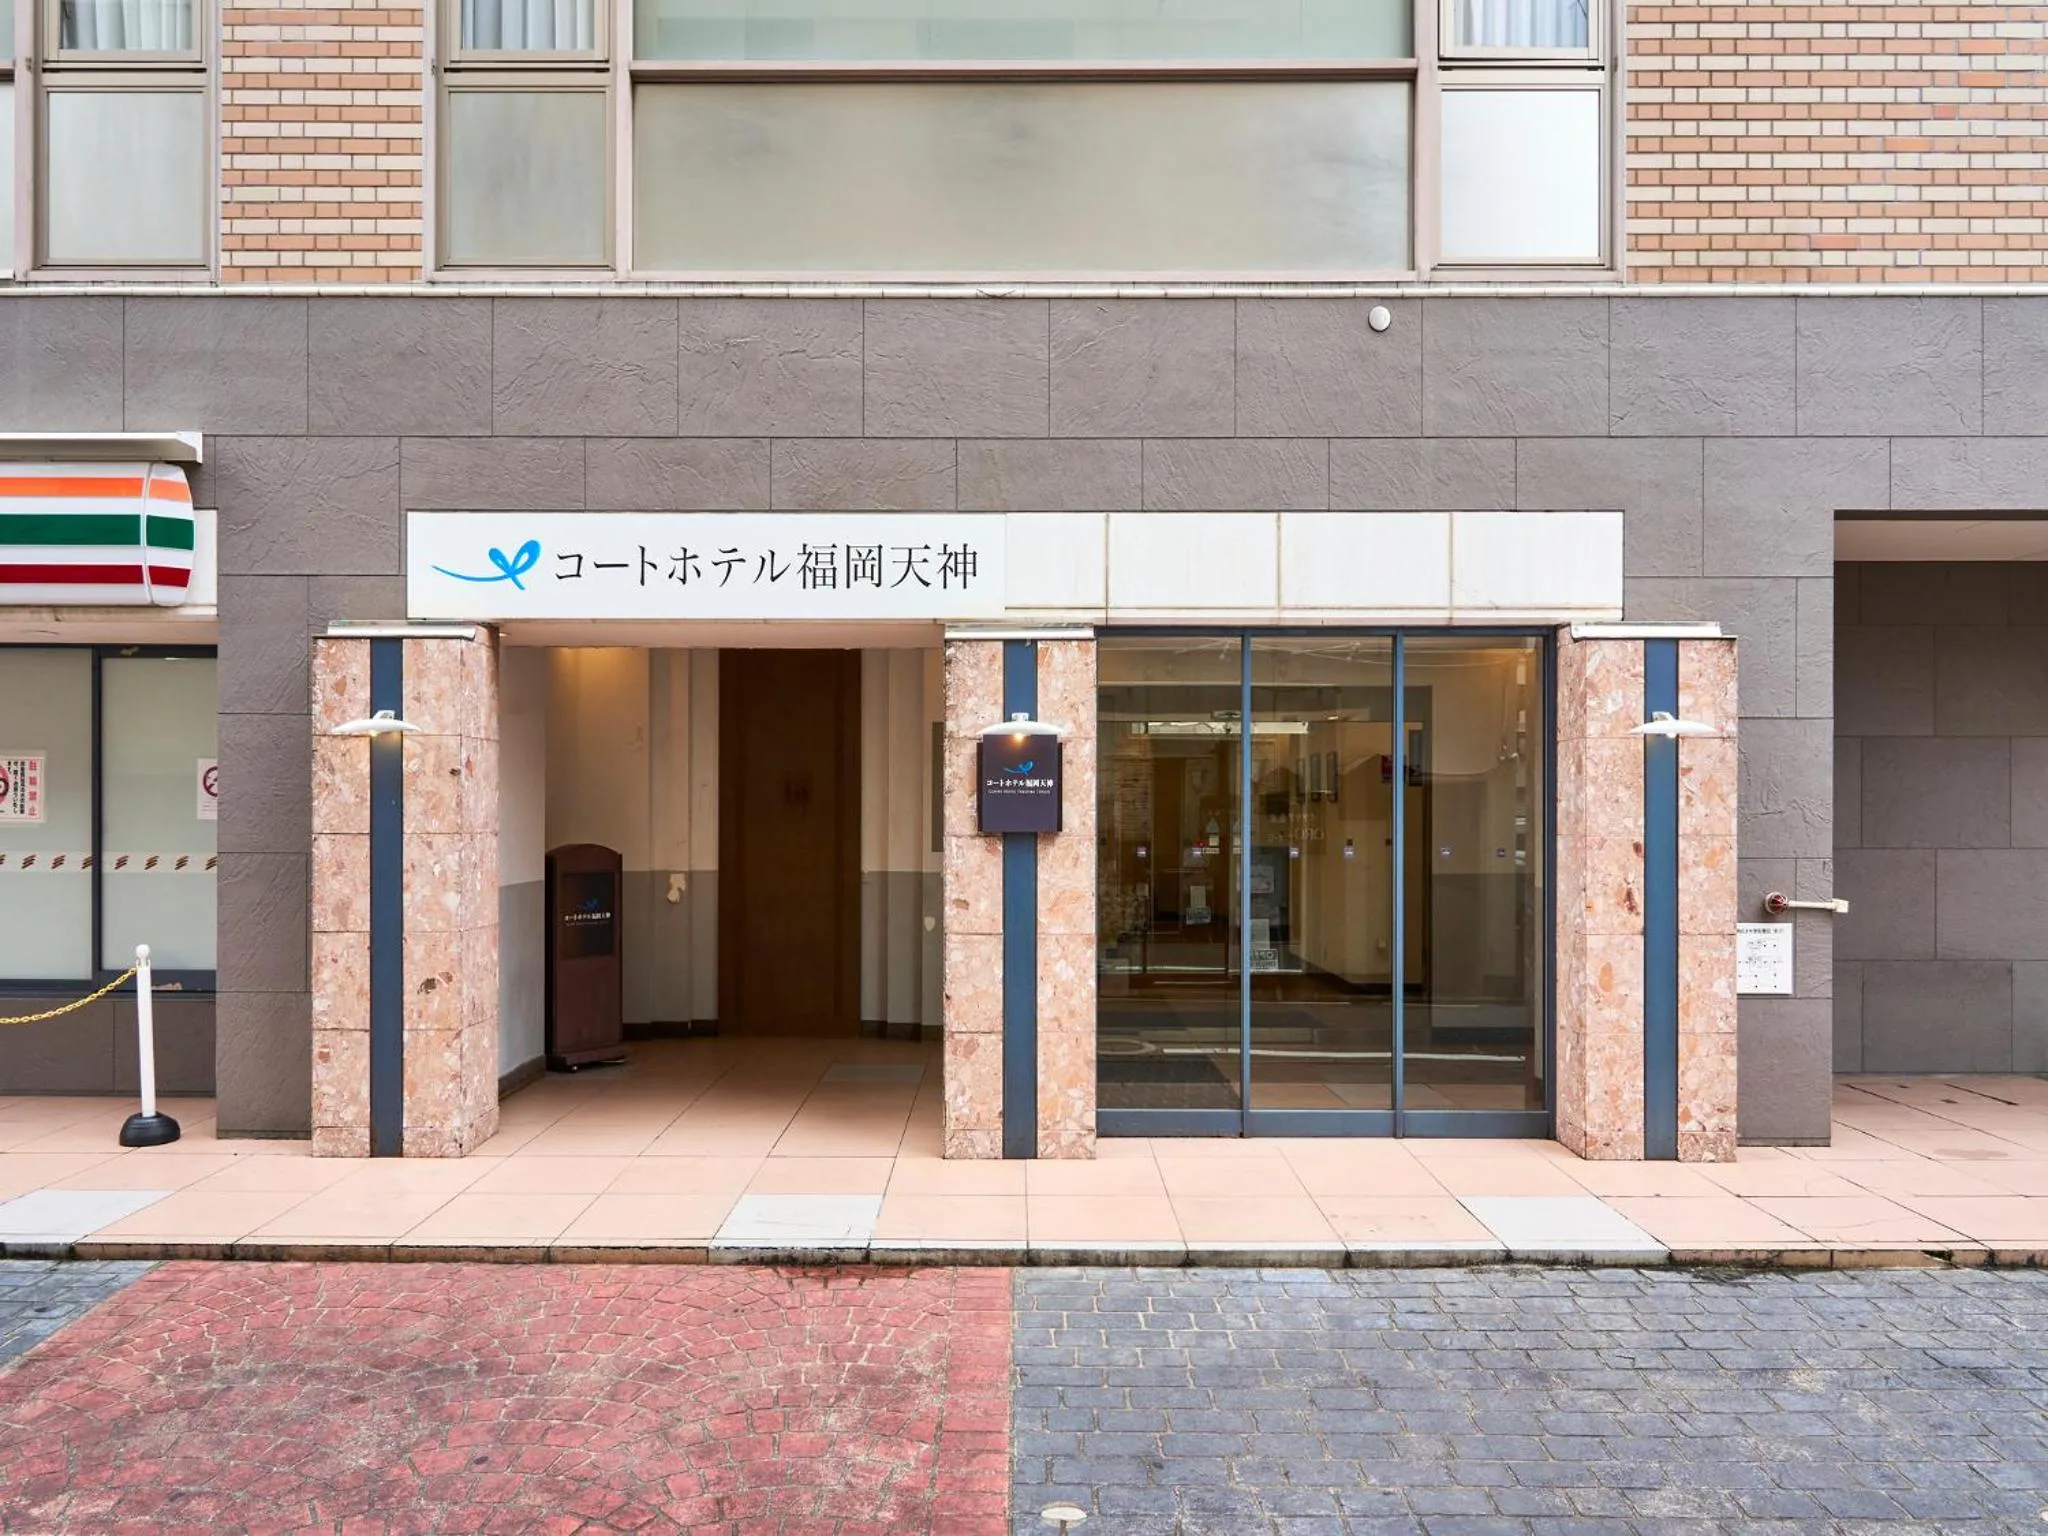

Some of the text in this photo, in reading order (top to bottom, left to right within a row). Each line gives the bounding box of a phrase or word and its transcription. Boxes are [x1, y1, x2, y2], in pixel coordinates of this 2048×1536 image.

[555, 543, 978, 590] コートホテル福岡天神
[986, 779, 1054, 788] コートホテル福岡天神
